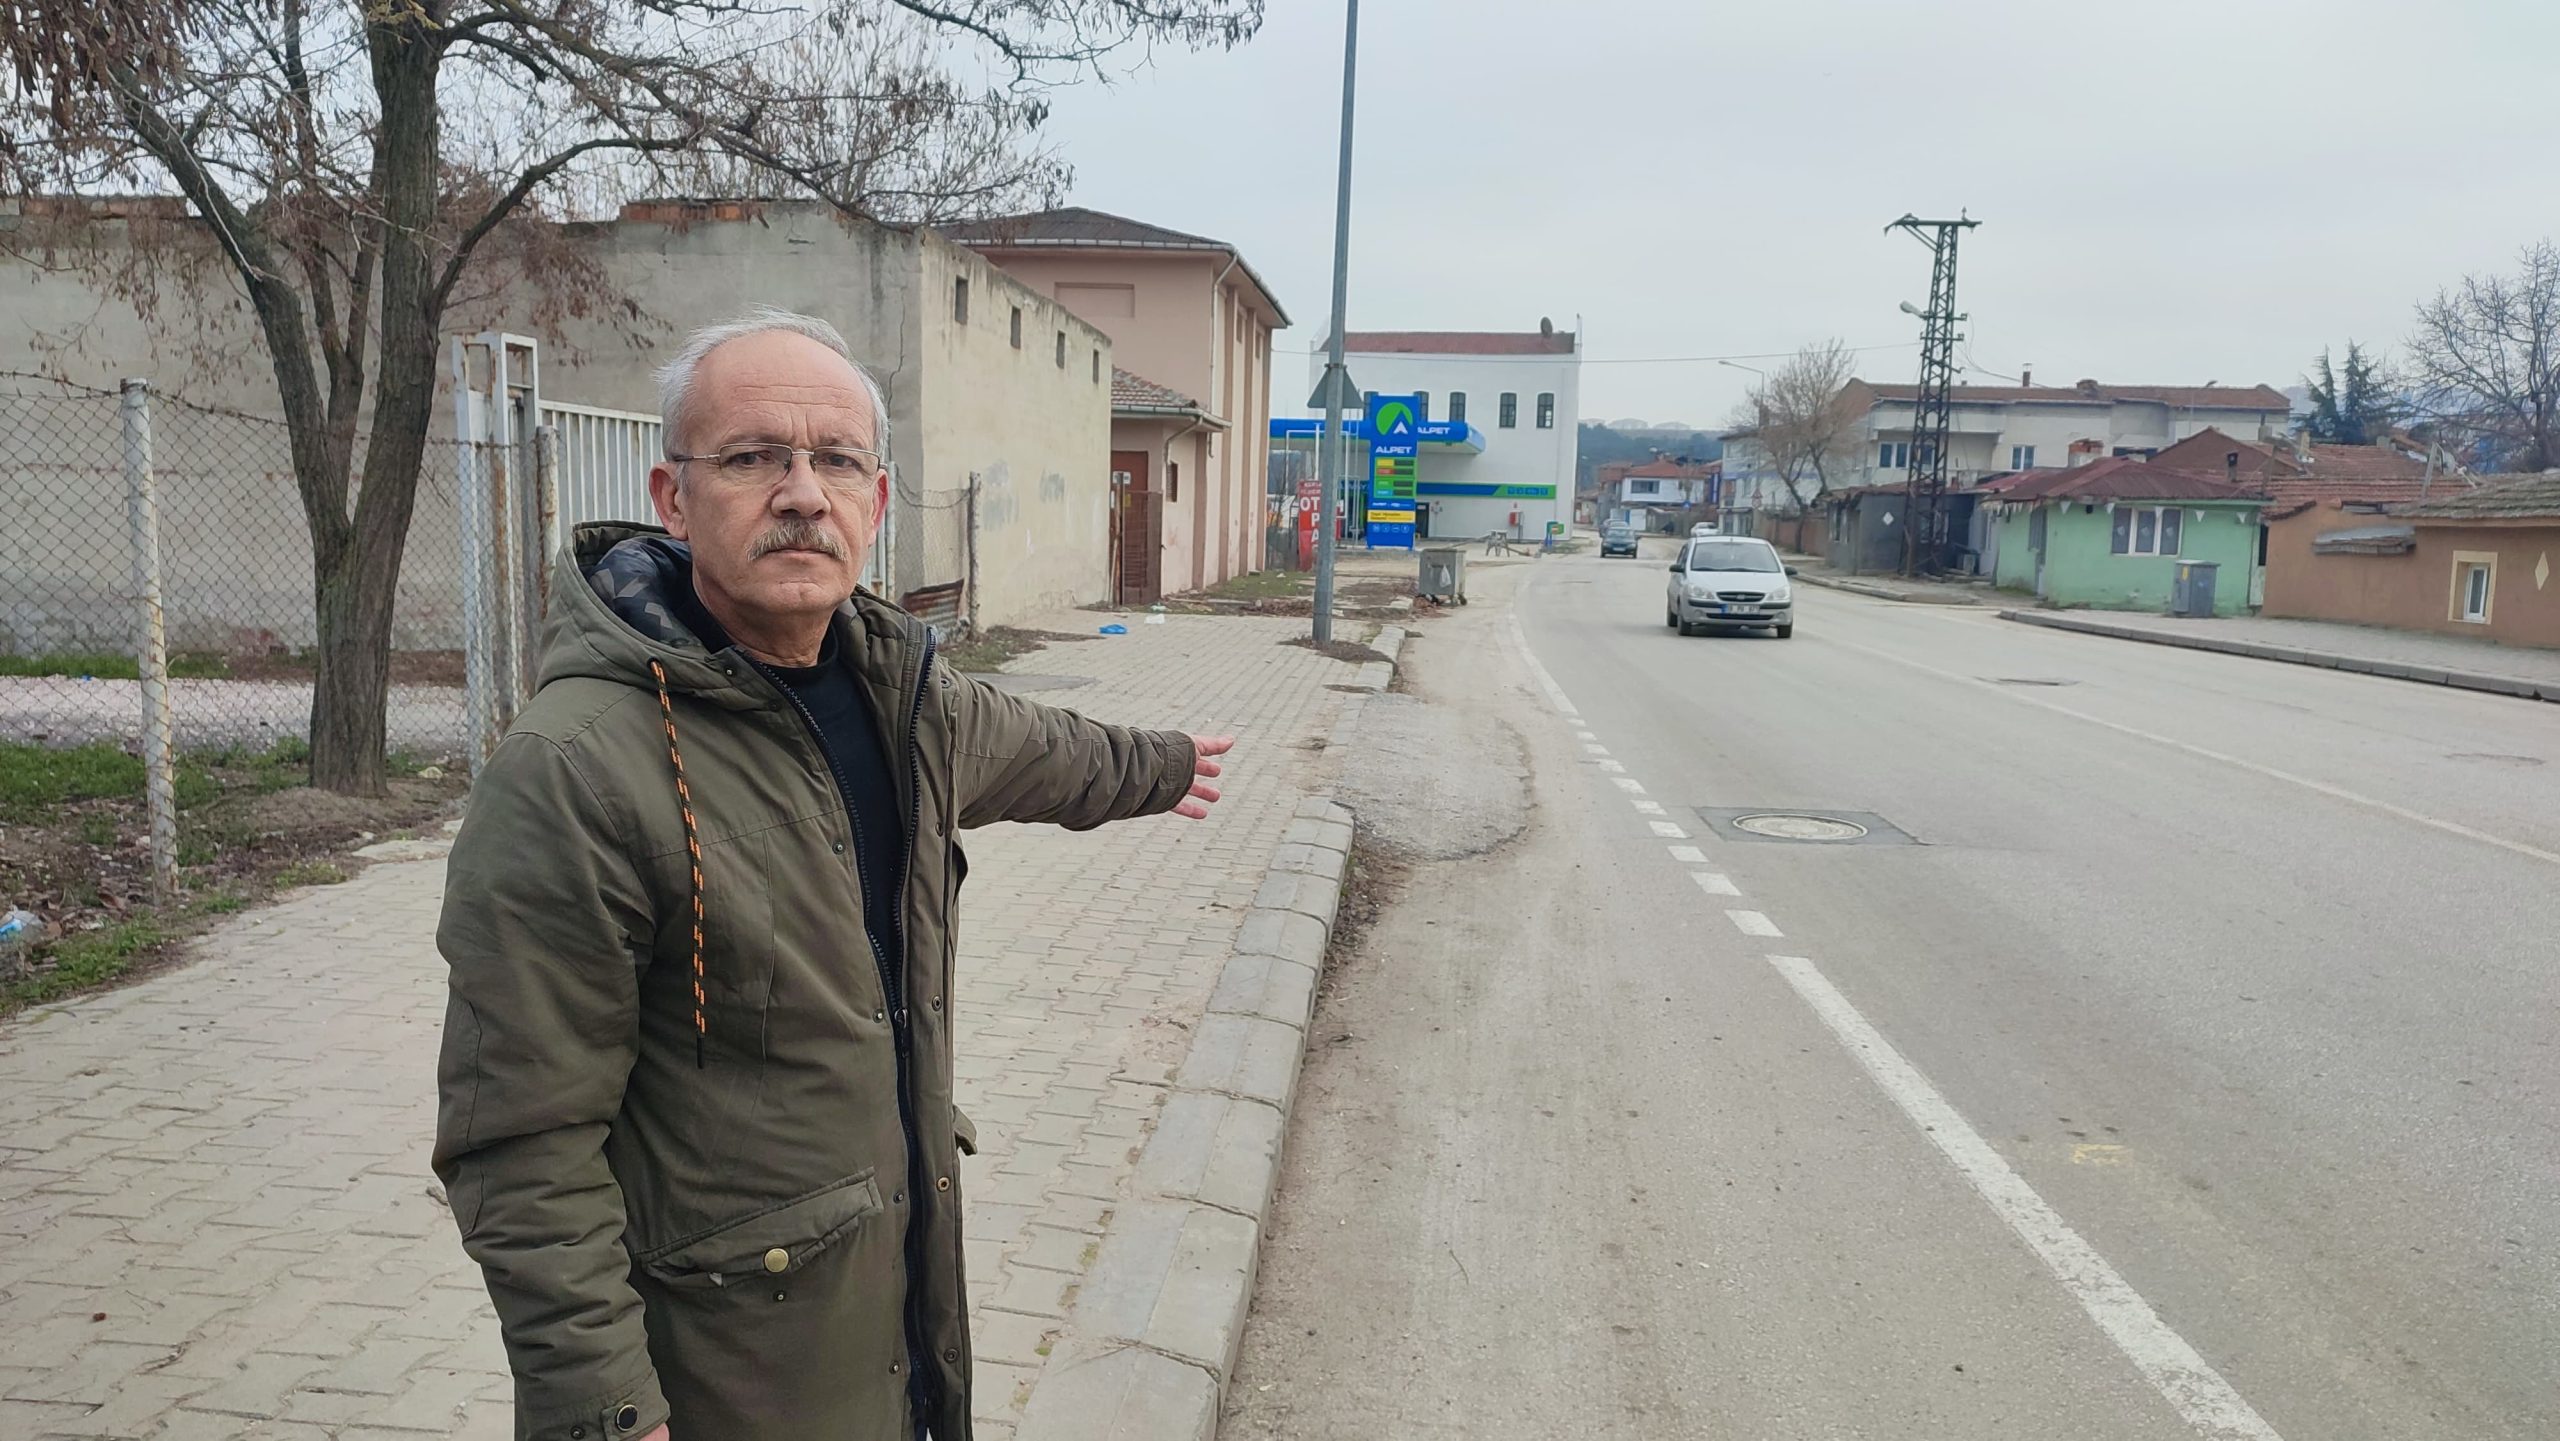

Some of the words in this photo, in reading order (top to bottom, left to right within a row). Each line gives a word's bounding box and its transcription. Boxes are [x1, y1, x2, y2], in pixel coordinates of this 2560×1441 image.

[1417, 426, 1451, 435] ALPET
[1375, 445, 1412, 454] ALPET
[1300, 496, 1321, 511] OT
